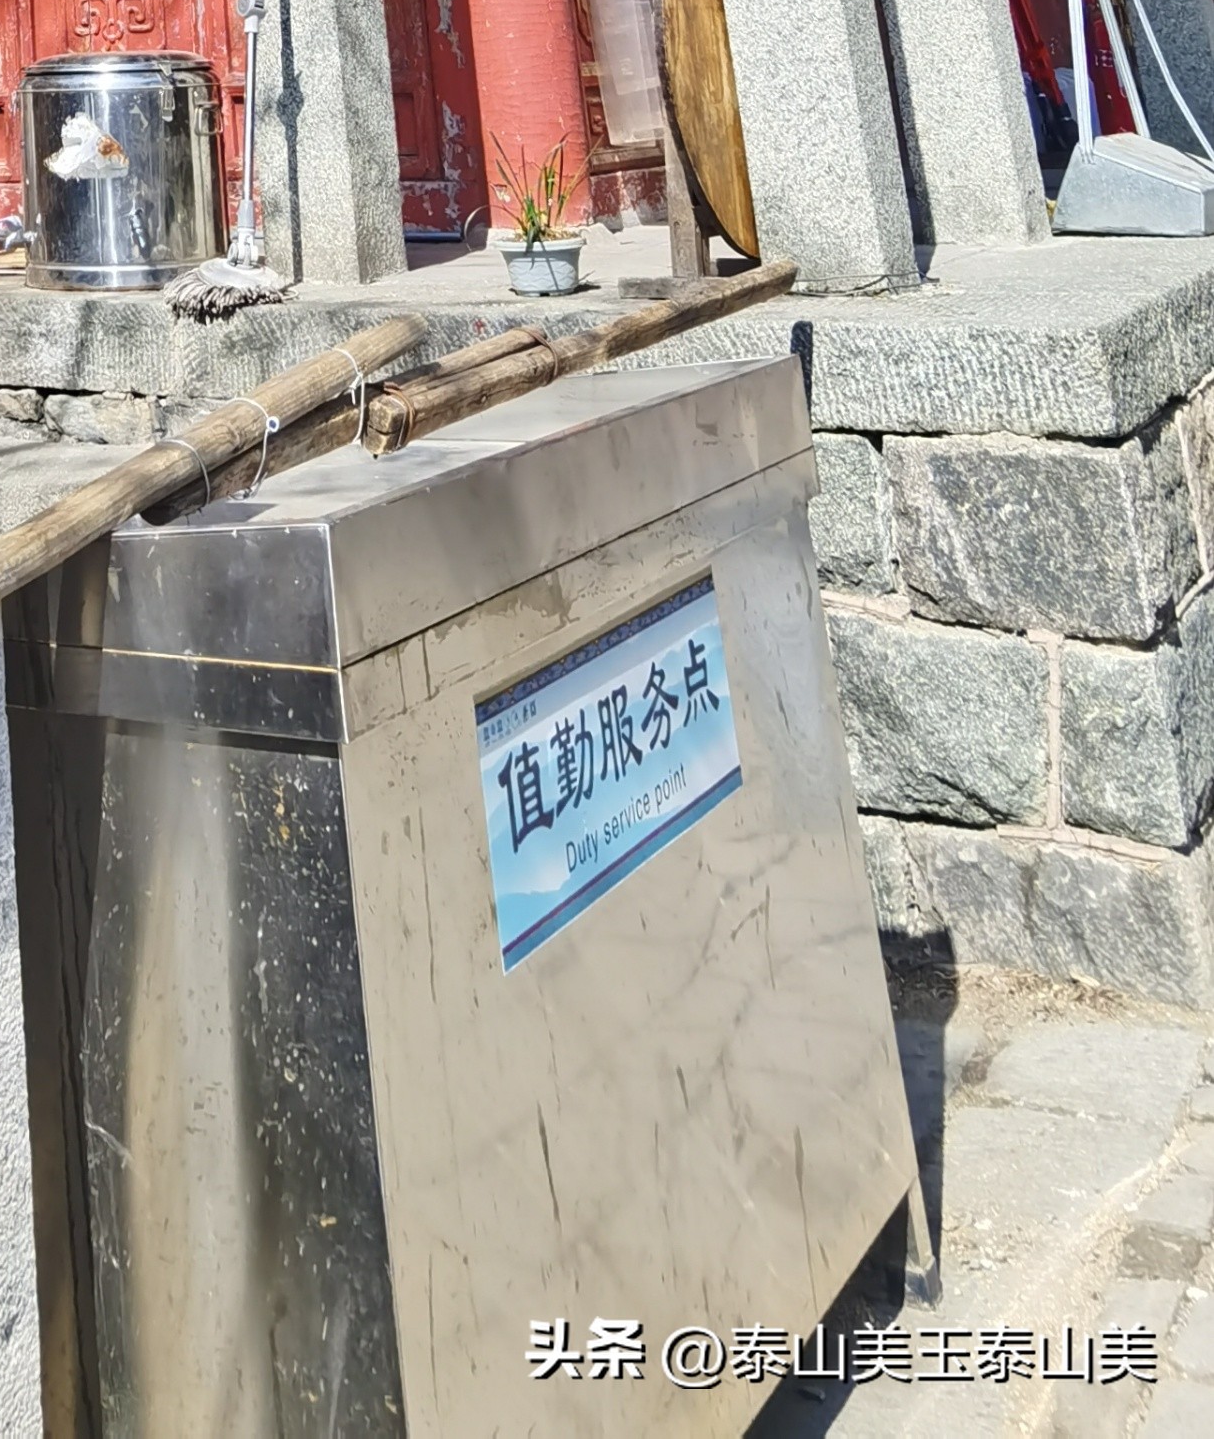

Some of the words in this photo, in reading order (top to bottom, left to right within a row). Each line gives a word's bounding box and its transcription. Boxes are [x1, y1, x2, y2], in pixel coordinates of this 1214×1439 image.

[497, 639, 720, 853] 值勤服务点
[565, 833, 600, 874] Duty
[603, 793, 653, 846] service
[655, 762, 688, 811] point
